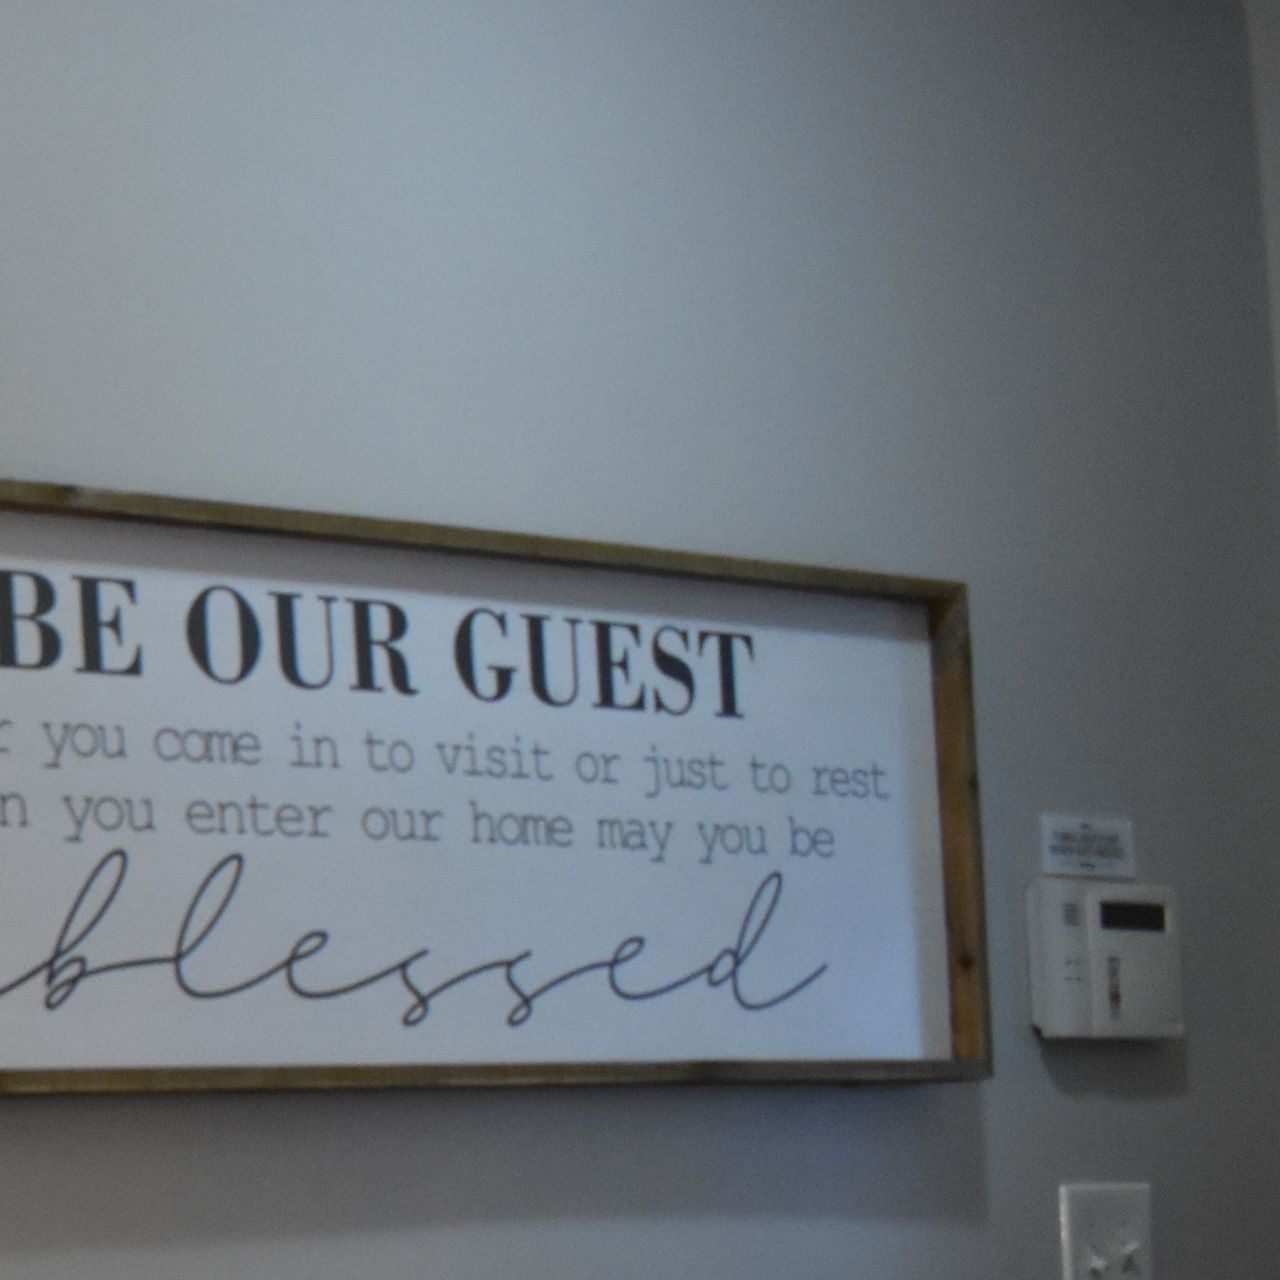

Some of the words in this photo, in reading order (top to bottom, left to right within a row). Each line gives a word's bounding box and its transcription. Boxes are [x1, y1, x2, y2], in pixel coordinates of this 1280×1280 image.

[186, 584, 418, 695] OUR
[454, 607, 754, 718] GUEST
[42, 720, 126, 767] you
[153, 724, 262, 766] come
[290, 721, 341, 769] in
[365, 728, 415, 773] to
[436, 732, 554, 782] visit
[576, 748, 621, 784] or
[644, 745, 730, 798] just
[750, 754, 791, 794] to
[813, 761, 890, 800] rest
[61, 792, 155, 842] you
[185, 796, 331, 839] enter
[361, 804, 441, 843] our
[470, 802, 574, 848] home
[596, 814, 673, 862] may
[698, 819, 767, 864] you
[788, 817, 836, 858] be
